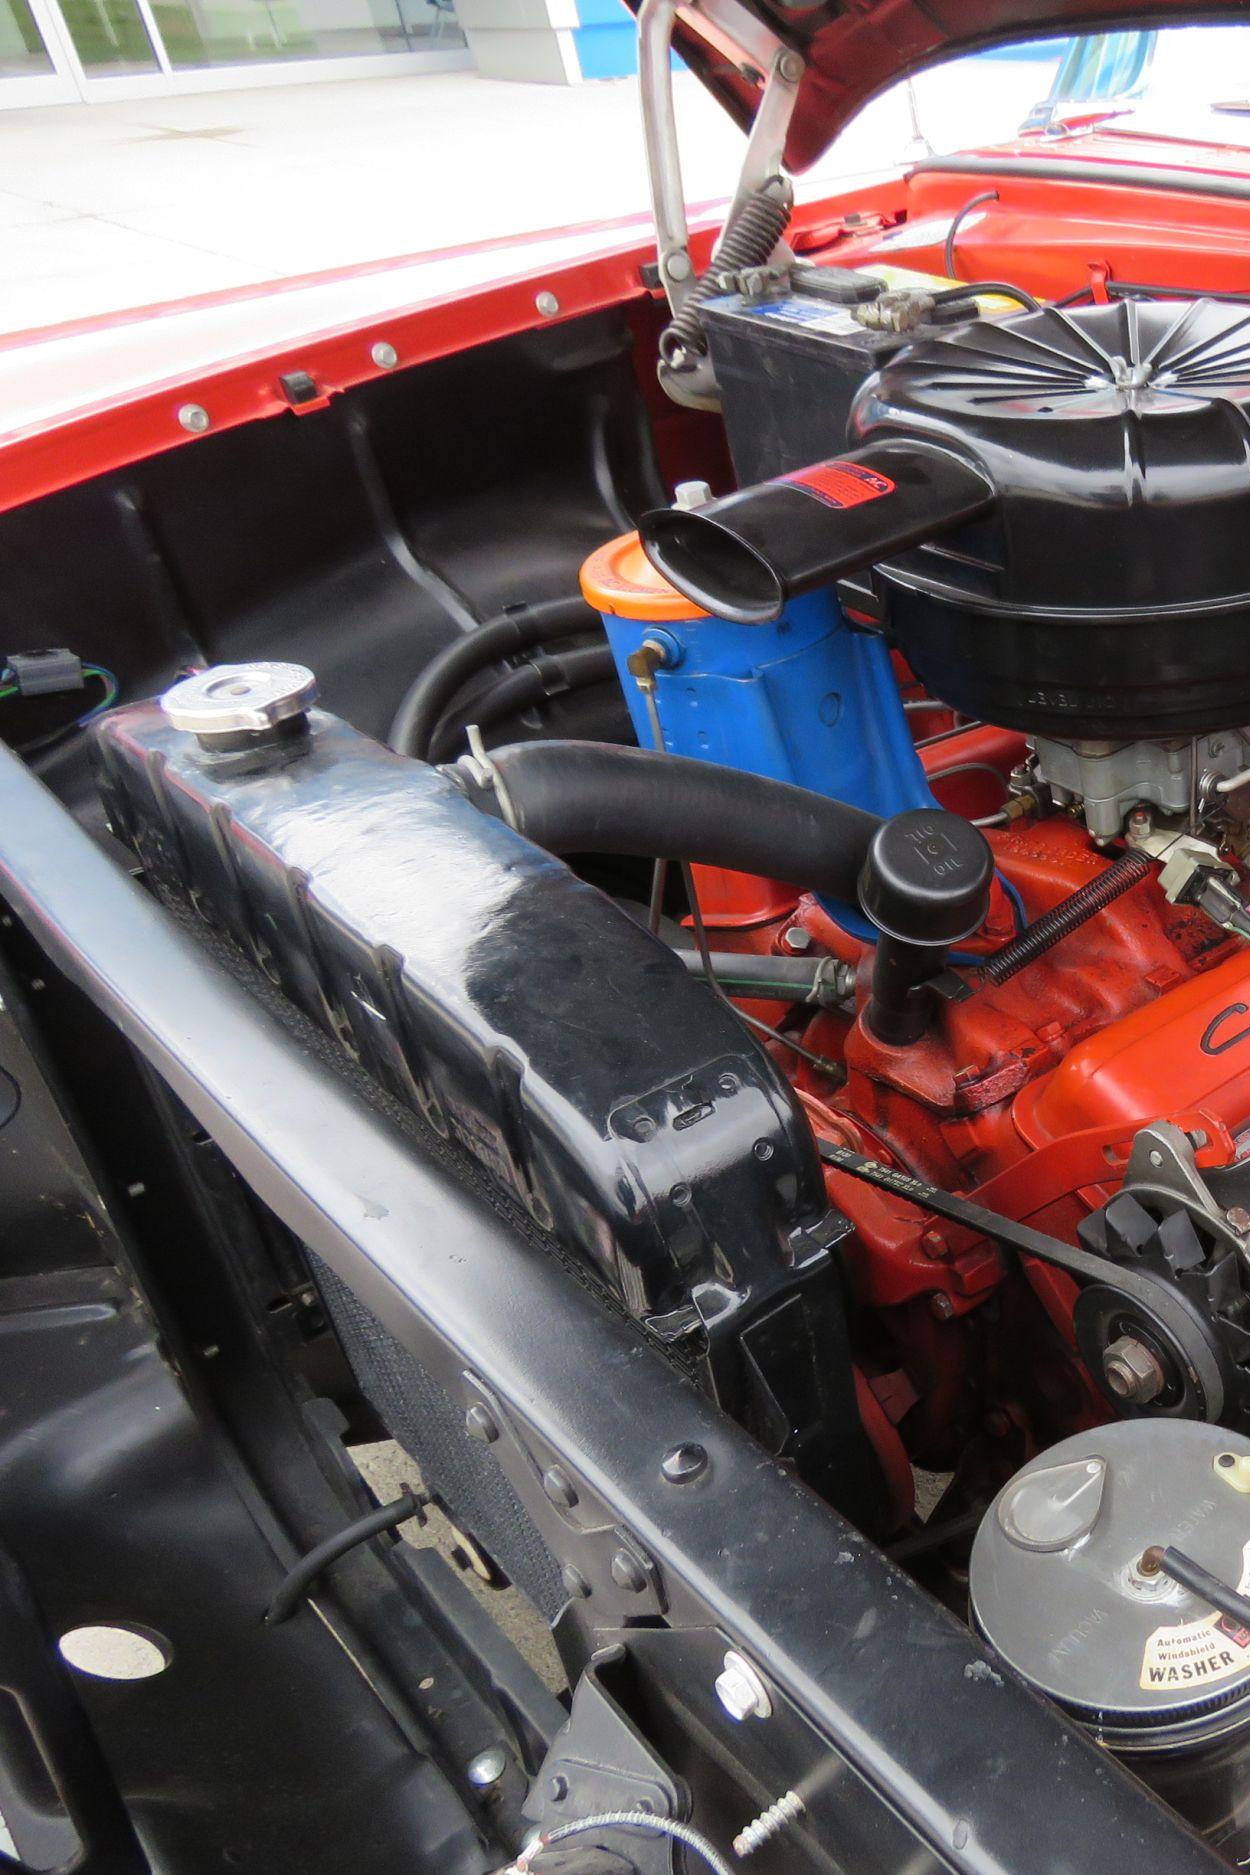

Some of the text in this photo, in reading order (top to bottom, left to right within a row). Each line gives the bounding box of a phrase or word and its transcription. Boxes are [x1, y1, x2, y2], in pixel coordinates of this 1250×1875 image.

[933, 858, 963, 876] OIL
[1157, 1629, 1212, 1647] Automatic
[1158, 1642, 1216, 1661] Windshield
[1149, 1651, 1235, 1683] WASHER
